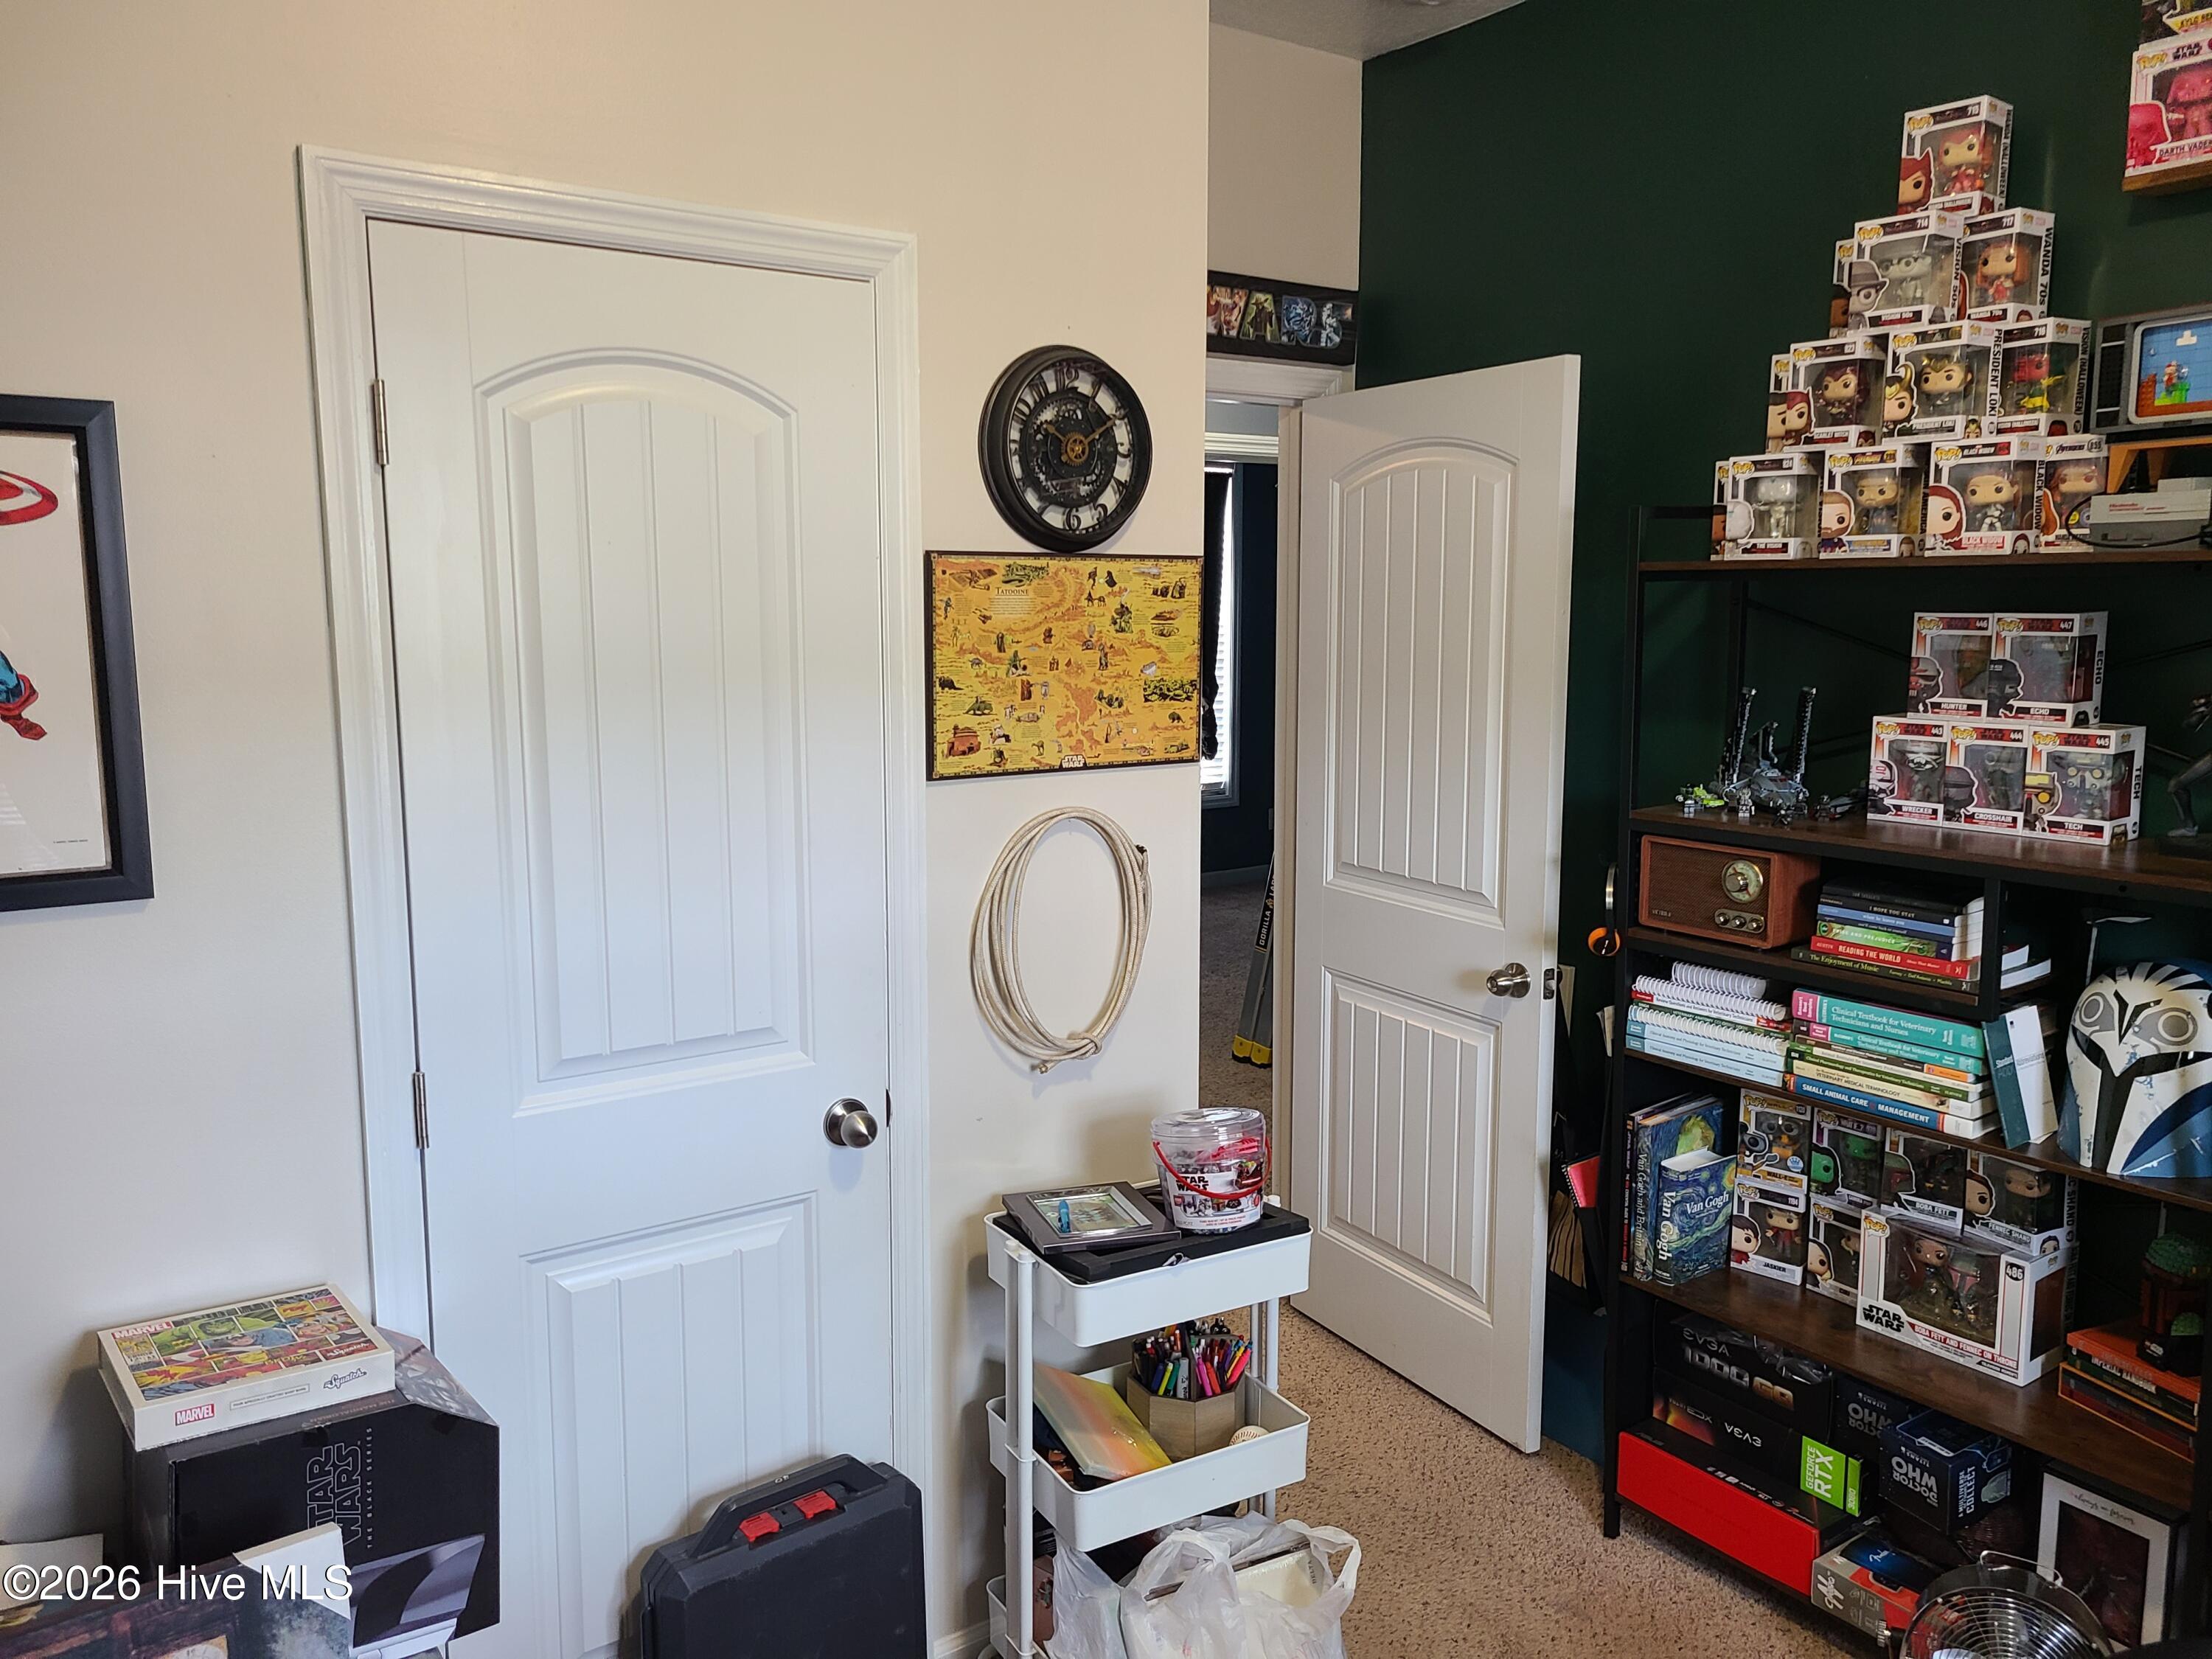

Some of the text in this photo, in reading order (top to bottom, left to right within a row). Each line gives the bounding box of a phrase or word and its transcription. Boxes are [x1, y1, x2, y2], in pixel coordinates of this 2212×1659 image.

[2159, 143, 2186, 157] DARTH
[2041, 227, 2053, 276] WANDA
[1989, 329, 2003, 417] PRESIDENT LOKI
[1829, 455, 1852, 468] POP!
[1935, 448, 1961, 461] POP!
[2034, 460, 2045, 529] BLACK WIDOW
[1962, 536, 2003, 544] BLACK WIDOW
[1919, 619, 1942, 632] POP!
[1997, 619, 2023, 633] POP!
[2095, 650, 2104, 684] ECHO
[1877, 723, 1899, 735] POP!
[1952, 726, 1976, 740] POP!
[2033, 733, 2059, 746] POP!
[2096, 737, 2110, 745] 445
[1062, 761, 1084, 769] WARS
[2133, 765, 2142, 799] TECH
[1902, 805, 1933, 814] WRECKER
[1975, 813, 2012, 823] CROSSHAIR
[1259, 910, 1271, 946] GORILLA
[1864, 933, 1895, 944] PREJUDICE
[1838, 945, 1864, 956] READING
[1865, 950, 1877, 959] THE
[1878, 953, 1902, 963] WORLD
[1820, 956, 1853, 968] Enjoyment
[1853, 961, 1860, 969] of
[1860, 963, 1879, 973] Music
[1714, 1009, 1731, 1019] Veterinary
[1832, 1006, 1937, 1035] Clinical Textbook for Veterinary
[1832, 1015, 1909, 1036] Technicians and Nurses
[1816, 1071, 1900, 1097] VETERINARY MEDICAL TERMINOLOGY
[1744, 1095, 1767, 1109] POP!
[1802, 1083, 1930, 1123] SMALL ANIMAL CARE MANAGEMENT
[1638, 1153, 1647, 1172] Van
[1636, 1172, 1646, 1194] Gogh
[1738, 1184, 1759, 1196] POP!
[1685, 1191, 1729, 1214] Van Gogh
[1813, 1204, 1833, 1215] POP!
[1916, 1203, 1950, 1217] BOBA FETT
[2066, 1190, 2076, 1228] SHAND
[1635, 1214, 1645, 1247] Britain
[1656, 1191, 1676, 1261] Van Gogh
[1864, 1217, 1887, 1234] POP!
[1989, 1222, 2031, 1242] FENNEC SHAND
[1763, 1262, 1787, 1273] JASKIER
[2006, 1263, 2023, 1280] 486
[1863, 1304, 1905, 1324] STAR
[1863, 1312, 1905, 1332] WARS
[111, 1321, 173, 1340] MARVEL
[1683, 1327, 1731, 1357] EVGA
[1914, 1325, 1930, 1338] BOBA
[1930, 1331, 1945, 1343] FETT
[1946, 1337, 1958, 1348] AND
[1959, 1340, 1982, 1356] FENNEC
[1983, 1350, 1993, 1360] ON
[1993, 1354, 2017, 1368] THRONE
[1683, 1346, 1750, 1388] 1000
[176, 1404, 215, 1425] MARVEL
[1848, 1402, 1893, 1430] WHO
[1725, 1422, 1762, 1447] EVGA
[1806, 1444, 1816, 1489] GEFORCE
[1907, 1450, 1930, 1467] TITANS
[1813, 1449, 1834, 1499] RTX
[1891, 1456, 1938, 1493] WHO
[307, 1445, 333, 1530] TAR
[1892, 1469, 1938, 1502] DOCTOR
[1966, 1466, 1975, 1513] COLLECT
